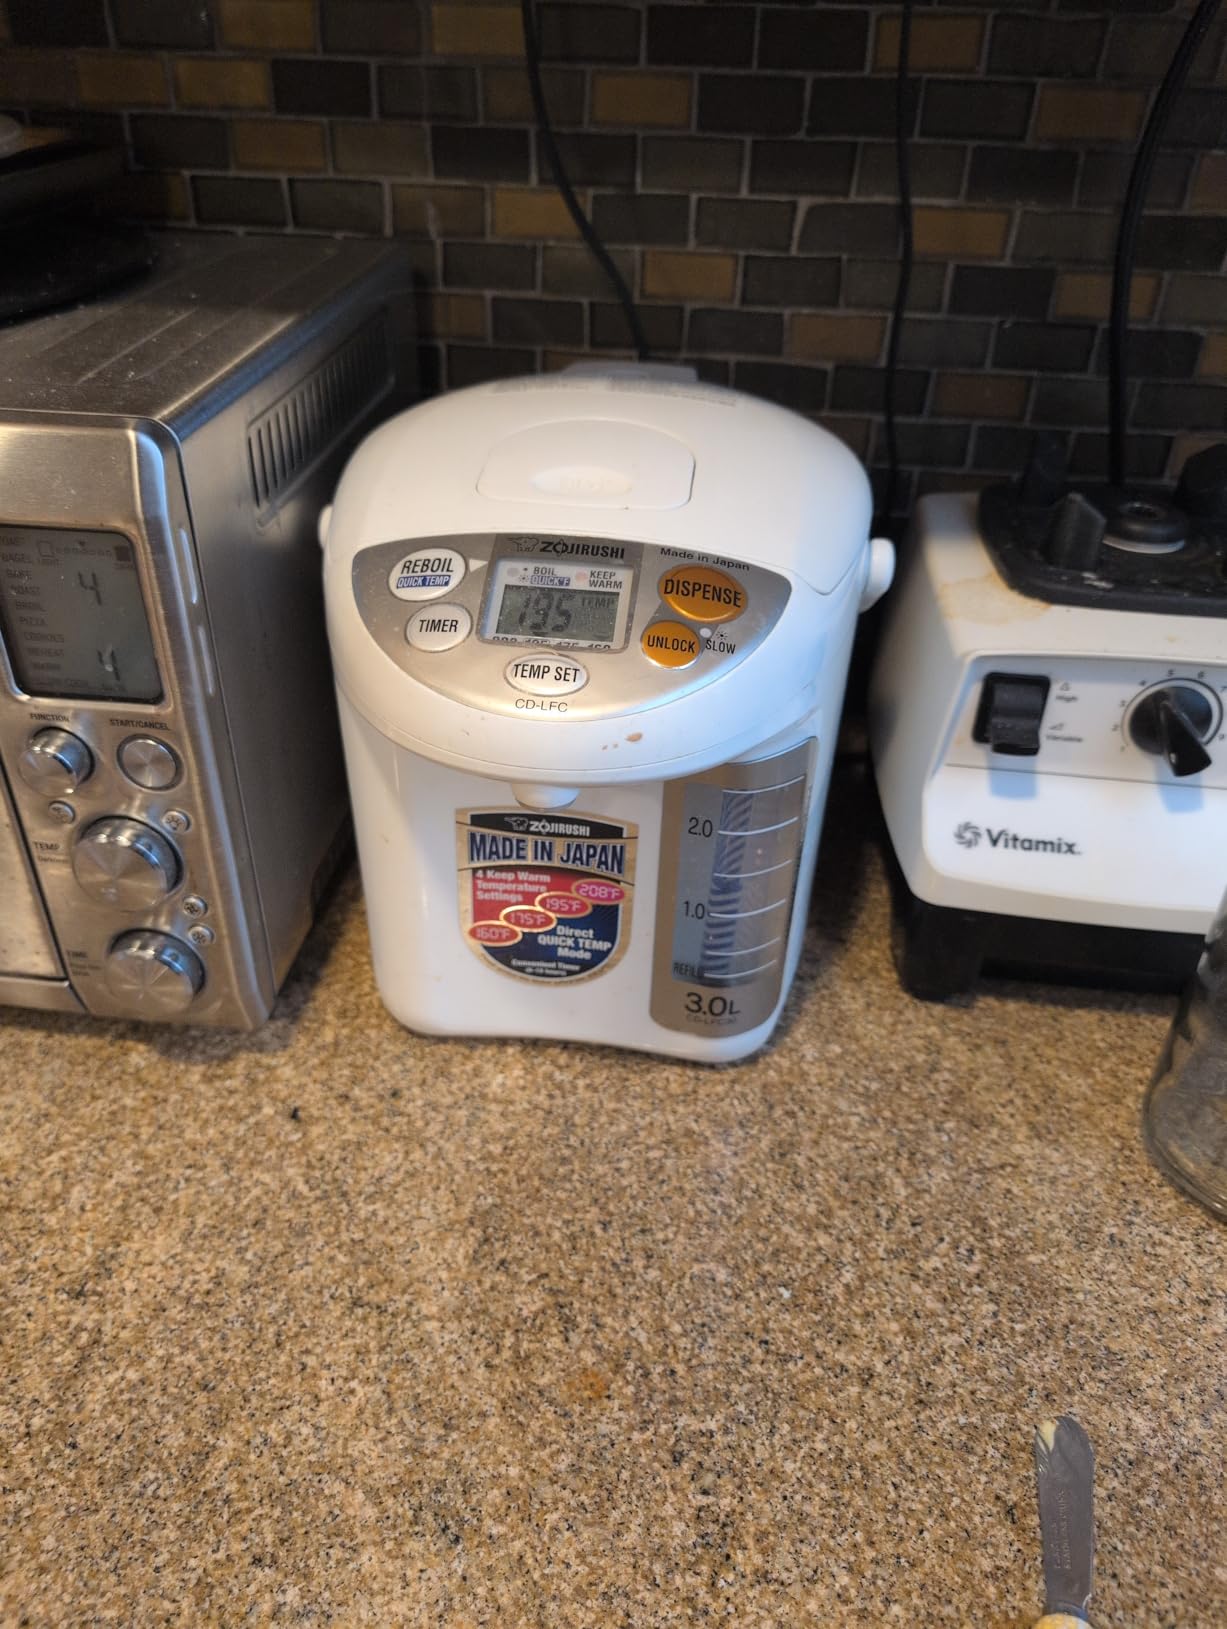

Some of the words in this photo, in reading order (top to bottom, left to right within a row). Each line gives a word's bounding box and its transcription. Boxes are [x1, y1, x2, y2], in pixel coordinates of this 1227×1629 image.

[540, 539, 625, 559] ZOJIRUSHI
[401, 557, 454, 574] REBOIL
[660, 547, 694, 560] Made
[698, 553, 709, 562] in
[713, 557, 750, 571] Japan
[533, 566, 556, 576] BOIL
[590, 570, 616, 580] KEEP
[78, 571, 102, 606] 4
[397, 575, 423, 587] QUICK
[425, 575, 450, 586] TEMP
[589, 580, 623, 589] WARM
[663, 578, 742, 608] DISPENSE
[581, 597, 615, 609] TEMP
[419, 618, 459, 632] TIMER
[647, 635, 696, 654] UNLOCK
[705, 639, 736, 655] SLOW
[514, 663, 550, 680] TEMP
[554, 666, 581, 683] SET
[515, 697, 568, 713] CD-LFC
[29, 712, 70, 722] FUNCTION
[109, 718, 171, 731] START/CANCEL
[530, 819, 590, 837] ZOJIRUSHI
[688, 817, 713, 838] 2.0
[33, 841, 60, 850] TEMP
[985, 828, 1077, 855] Vitamix
[469, 831, 528, 861] MADE
[534, 839, 553, 862] IN
[560, 843, 625, 875] JAPAN
[475, 870, 484, 878] 4
[486, 870, 516, 881] Keep
[517, 871, 551, 883] Warm
[476, 880, 547, 893] Temperature
[476, 890, 523, 902] Settings
[683, 901, 705, 919] 1.0
[556, 925, 594, 938] Direct
[537, 934, 575, 948] QUICK
[579, 939, 612, 951] TEMP
[557, 947, 592, 960] Mode
[684, 992, 741, 1017] 3.0L
